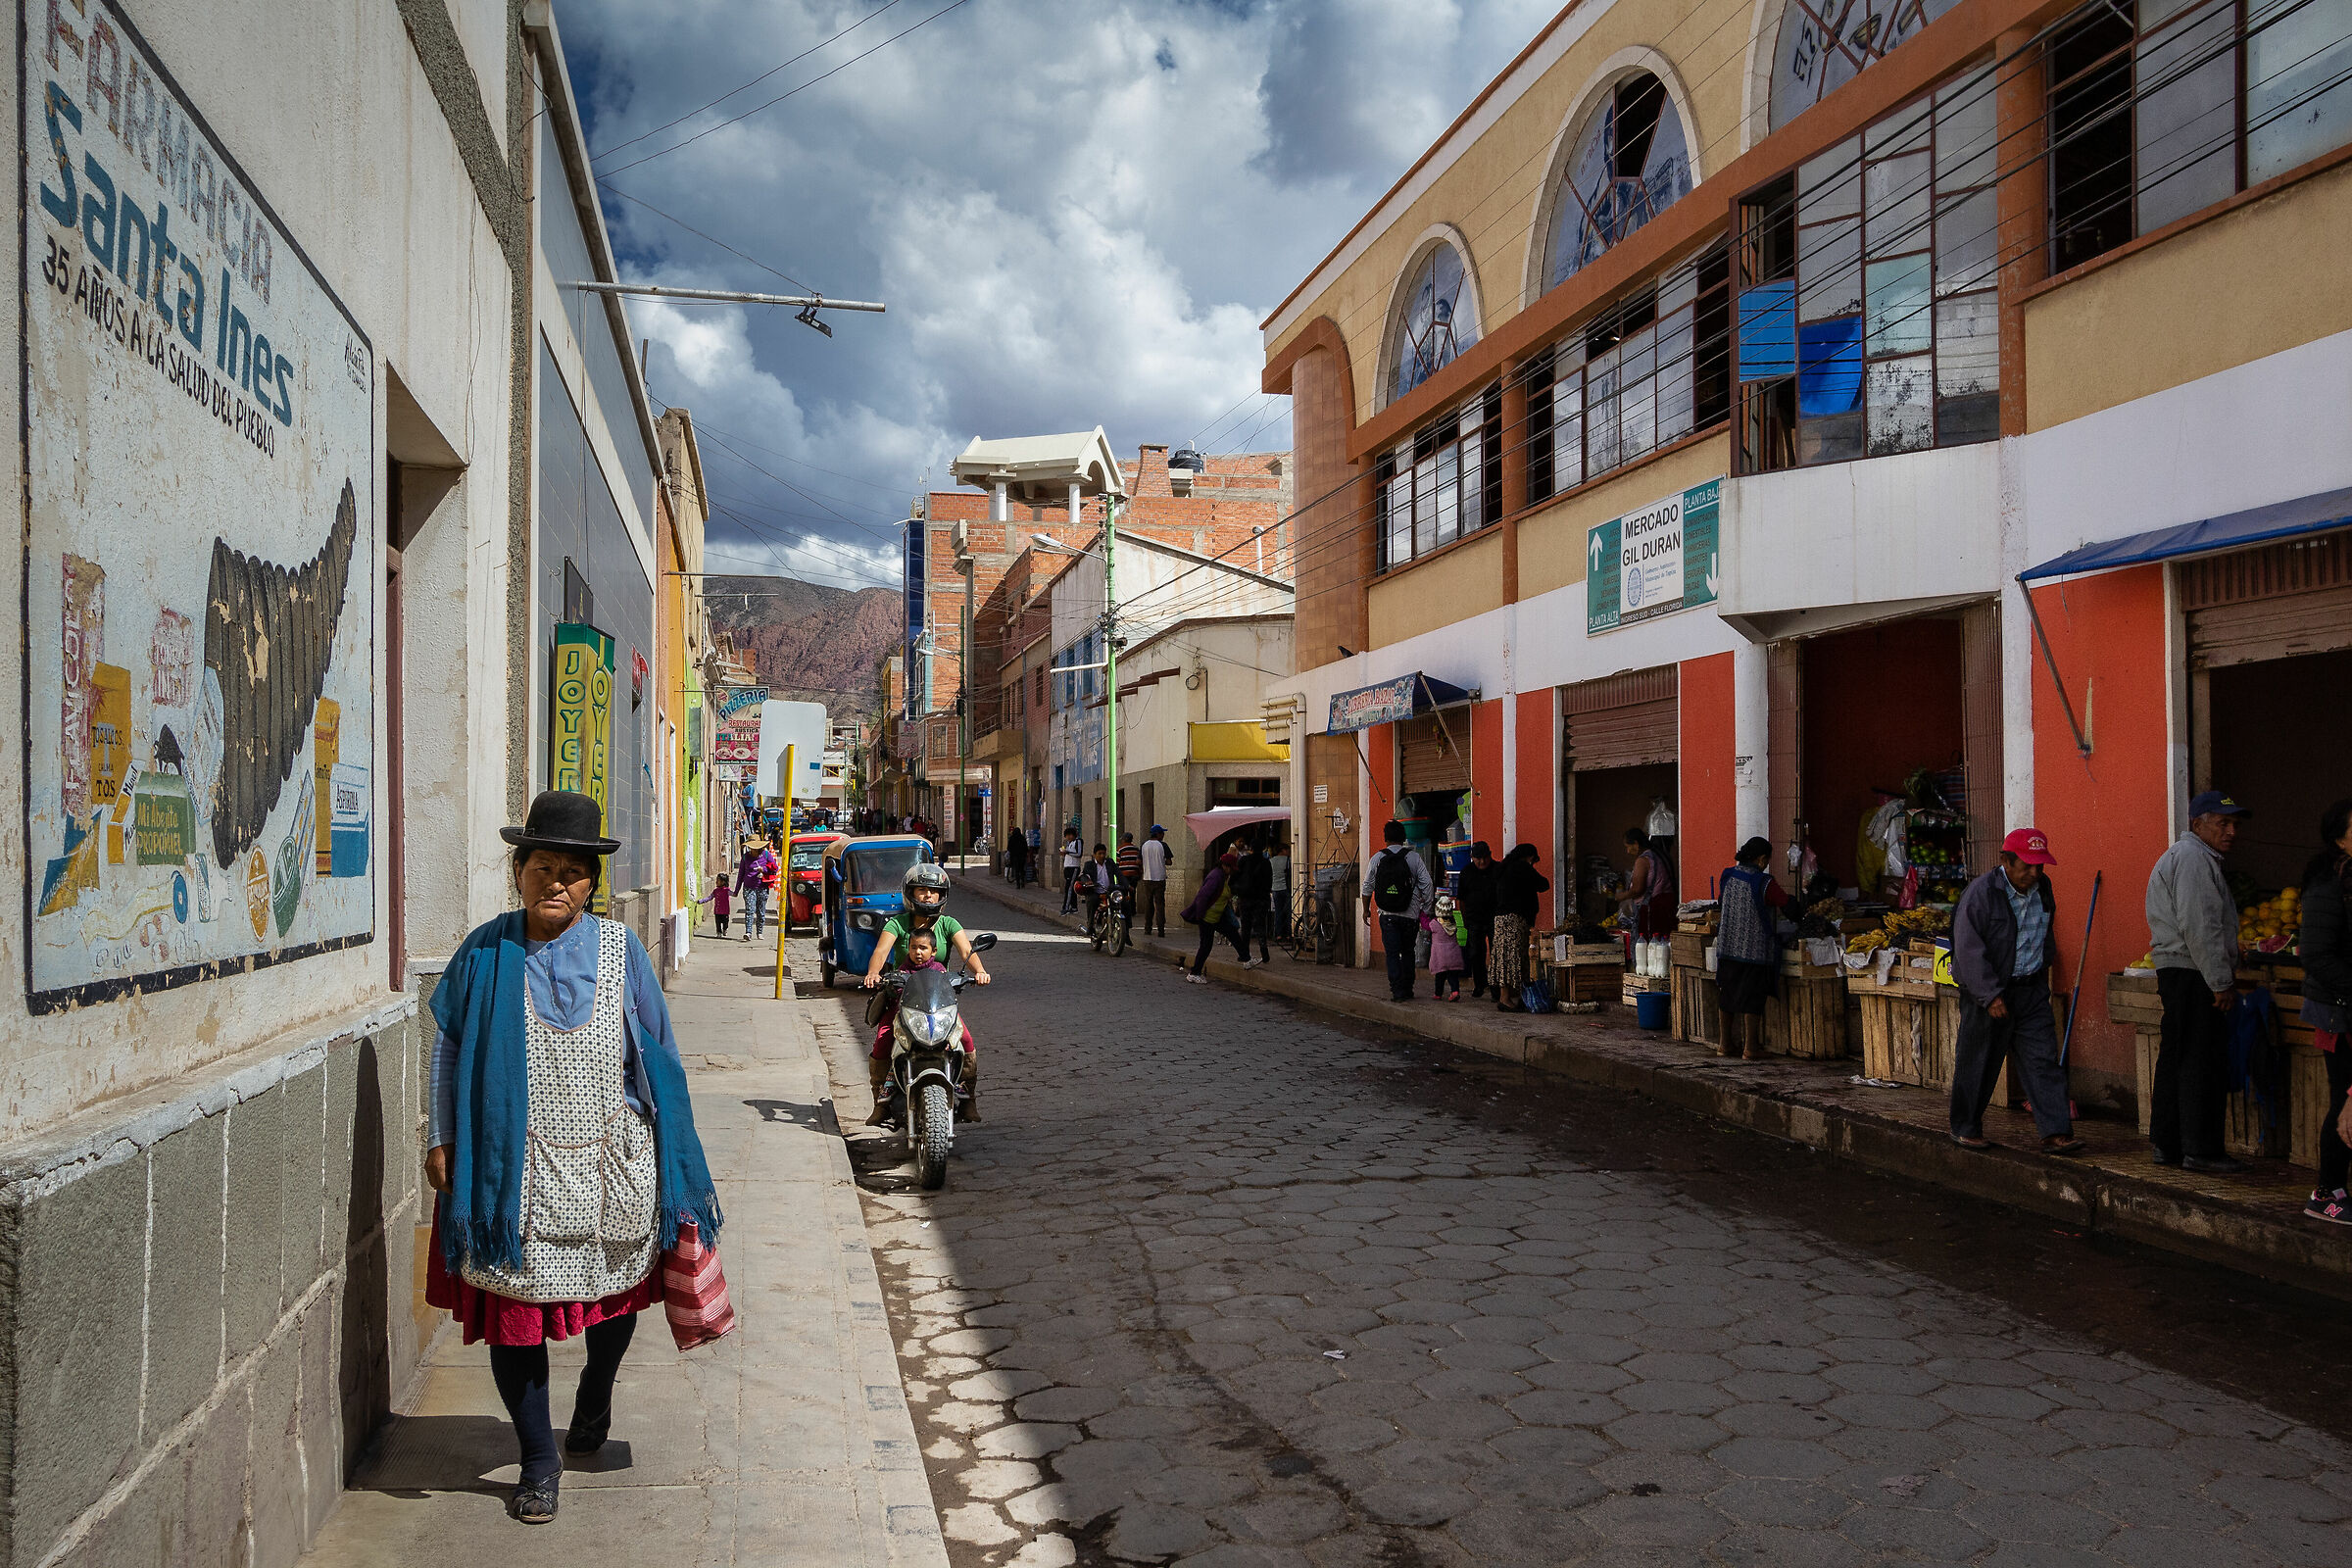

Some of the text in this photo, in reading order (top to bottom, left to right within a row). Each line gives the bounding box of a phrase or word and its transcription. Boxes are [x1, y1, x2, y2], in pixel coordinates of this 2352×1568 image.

[45, 0, 271, 304] FARMACIA
[40, 80, 293, 427] Santa Ines
[41, 234, 274, 459] 35 AÑOS A LA SALUD DEL PUEBLO
[1685, 486, 1720, 511] PLANTA BAJ
[1625, 504, 1679, 540] MERCADO
[1623, 530, 1681, 566] GIL DURAN
[1589, 611, 1619, 627] PLANTA ALTA
[1650, 606, 1664, 617] CALLE
[1664, 601, 1683, 612] FLORIDA
[718, 689, 767, 721] PIZZERIA
[96, 780, 116, 798] TOS
[137, 802, 150, 826] Mi
